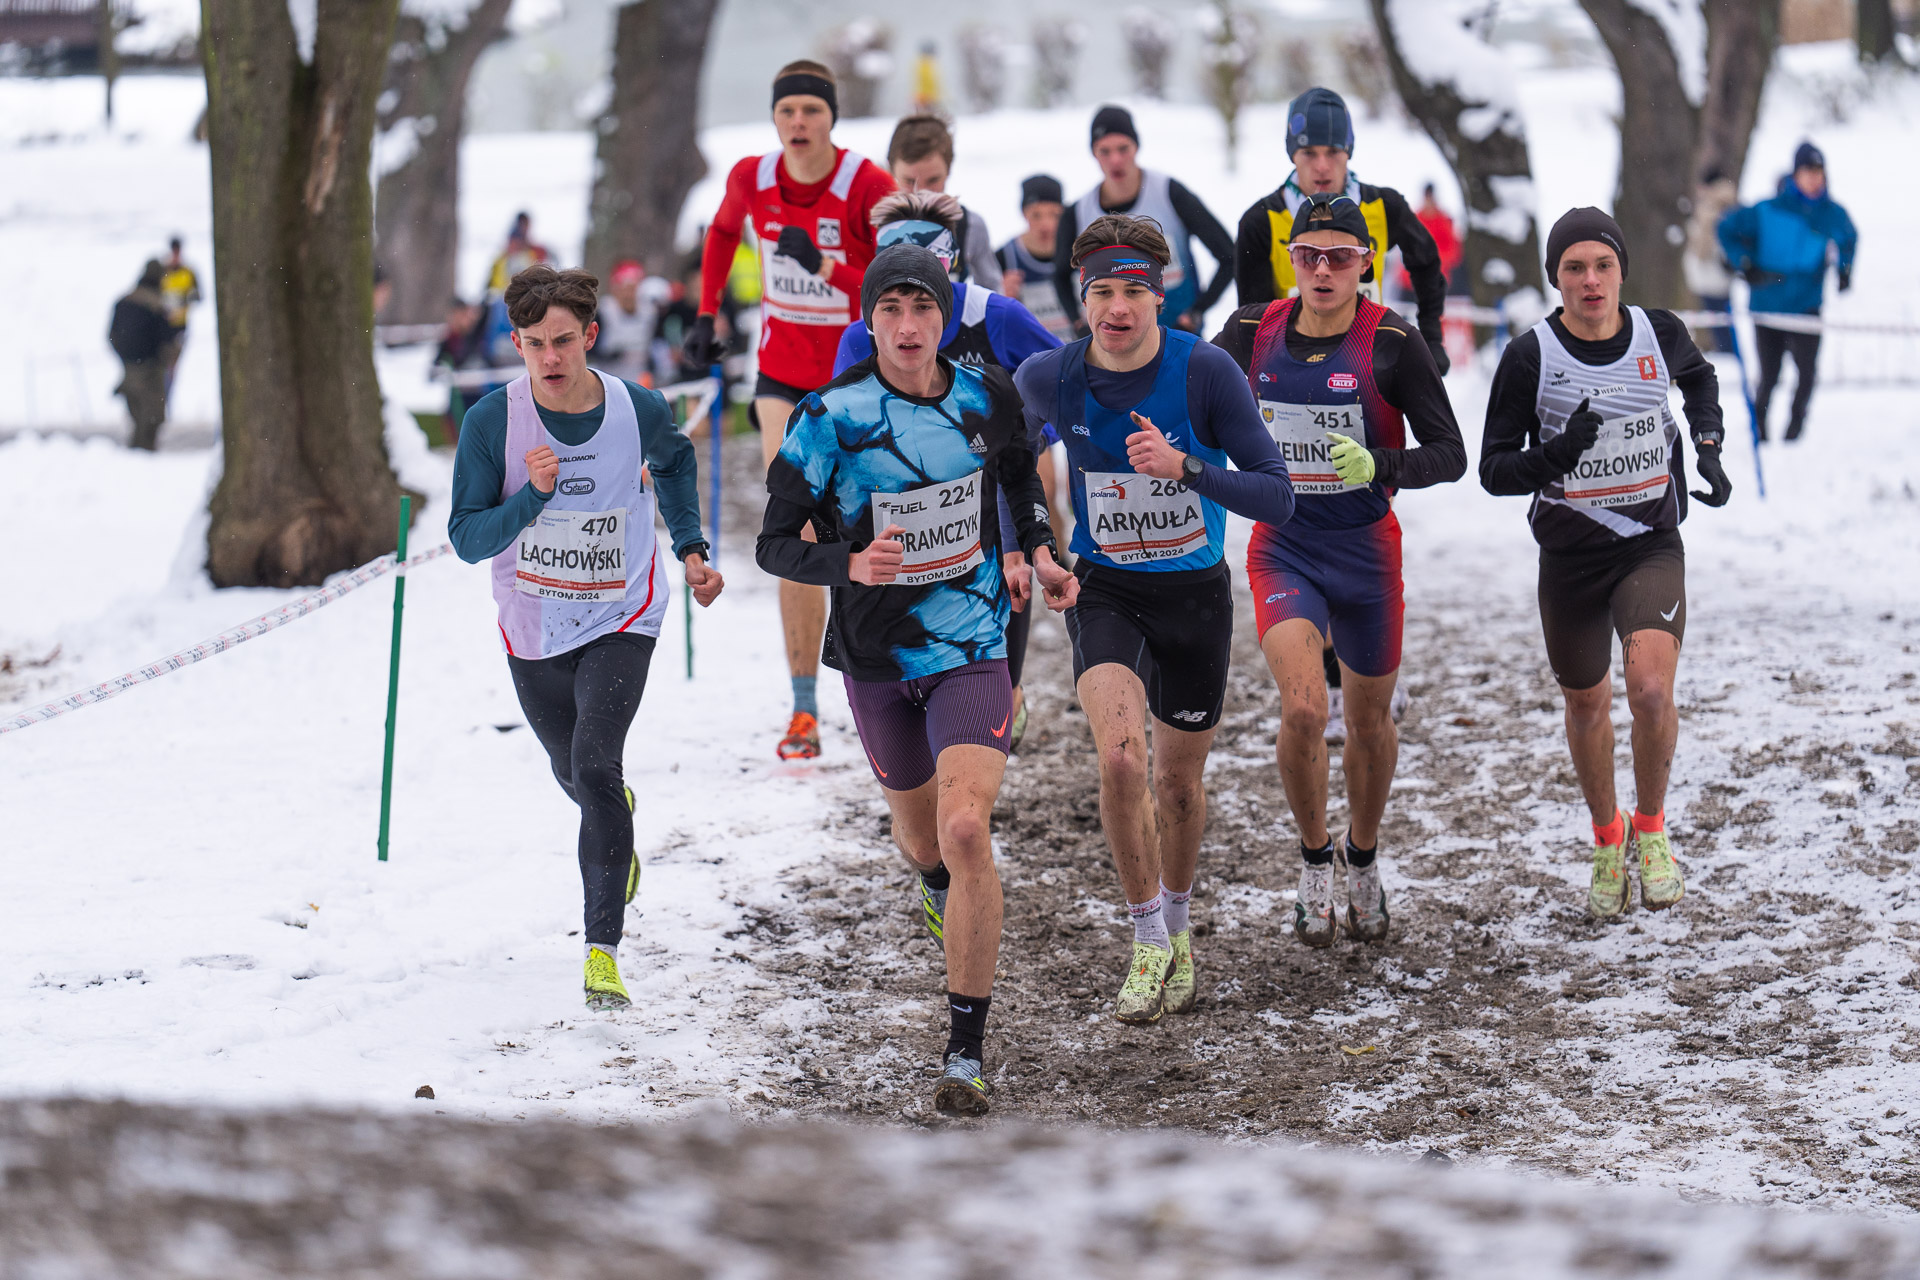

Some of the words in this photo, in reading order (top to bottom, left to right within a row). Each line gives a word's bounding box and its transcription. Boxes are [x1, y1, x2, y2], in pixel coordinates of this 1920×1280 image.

[1110, 263, 1151, 273] IMPRODEX
[774, 276, 833, 297] KILIAN
[1306, 354, 1327, 363] 4F
[1601, 385, 1625, 395] WERSAL
[1314, 411, 1353, 429] 451
[1072, 424, 1091, 437] esa
[1624, 416, 1656, 440] 588
[967, 445, 988, 454] adidas
[558, 454, 596, 464] SALOMON
[939, 480, 975, 509] 224
[1090, 490, 1118, 499] polanik
[1319, 484, 1344, 492] 2024
[1591, 498, 1625, 507] BYTOM
[1627, 492, 1648, 503] 2024
[891, 501, 928, 515] FUEL
[581, 515, 617, 536] 470
[1095, 504, 1199, 534] ARMUŁA
[1121, 551, 1158, 562] BYTOM
[1159, 547, 1185, 557] 2024
[907, 571, 944, 583] BYTOM
[945, 563, 968, 577] 2024
[539, 588, 574, 600] BYTOM
[575, 592, 600, 600] 2024
